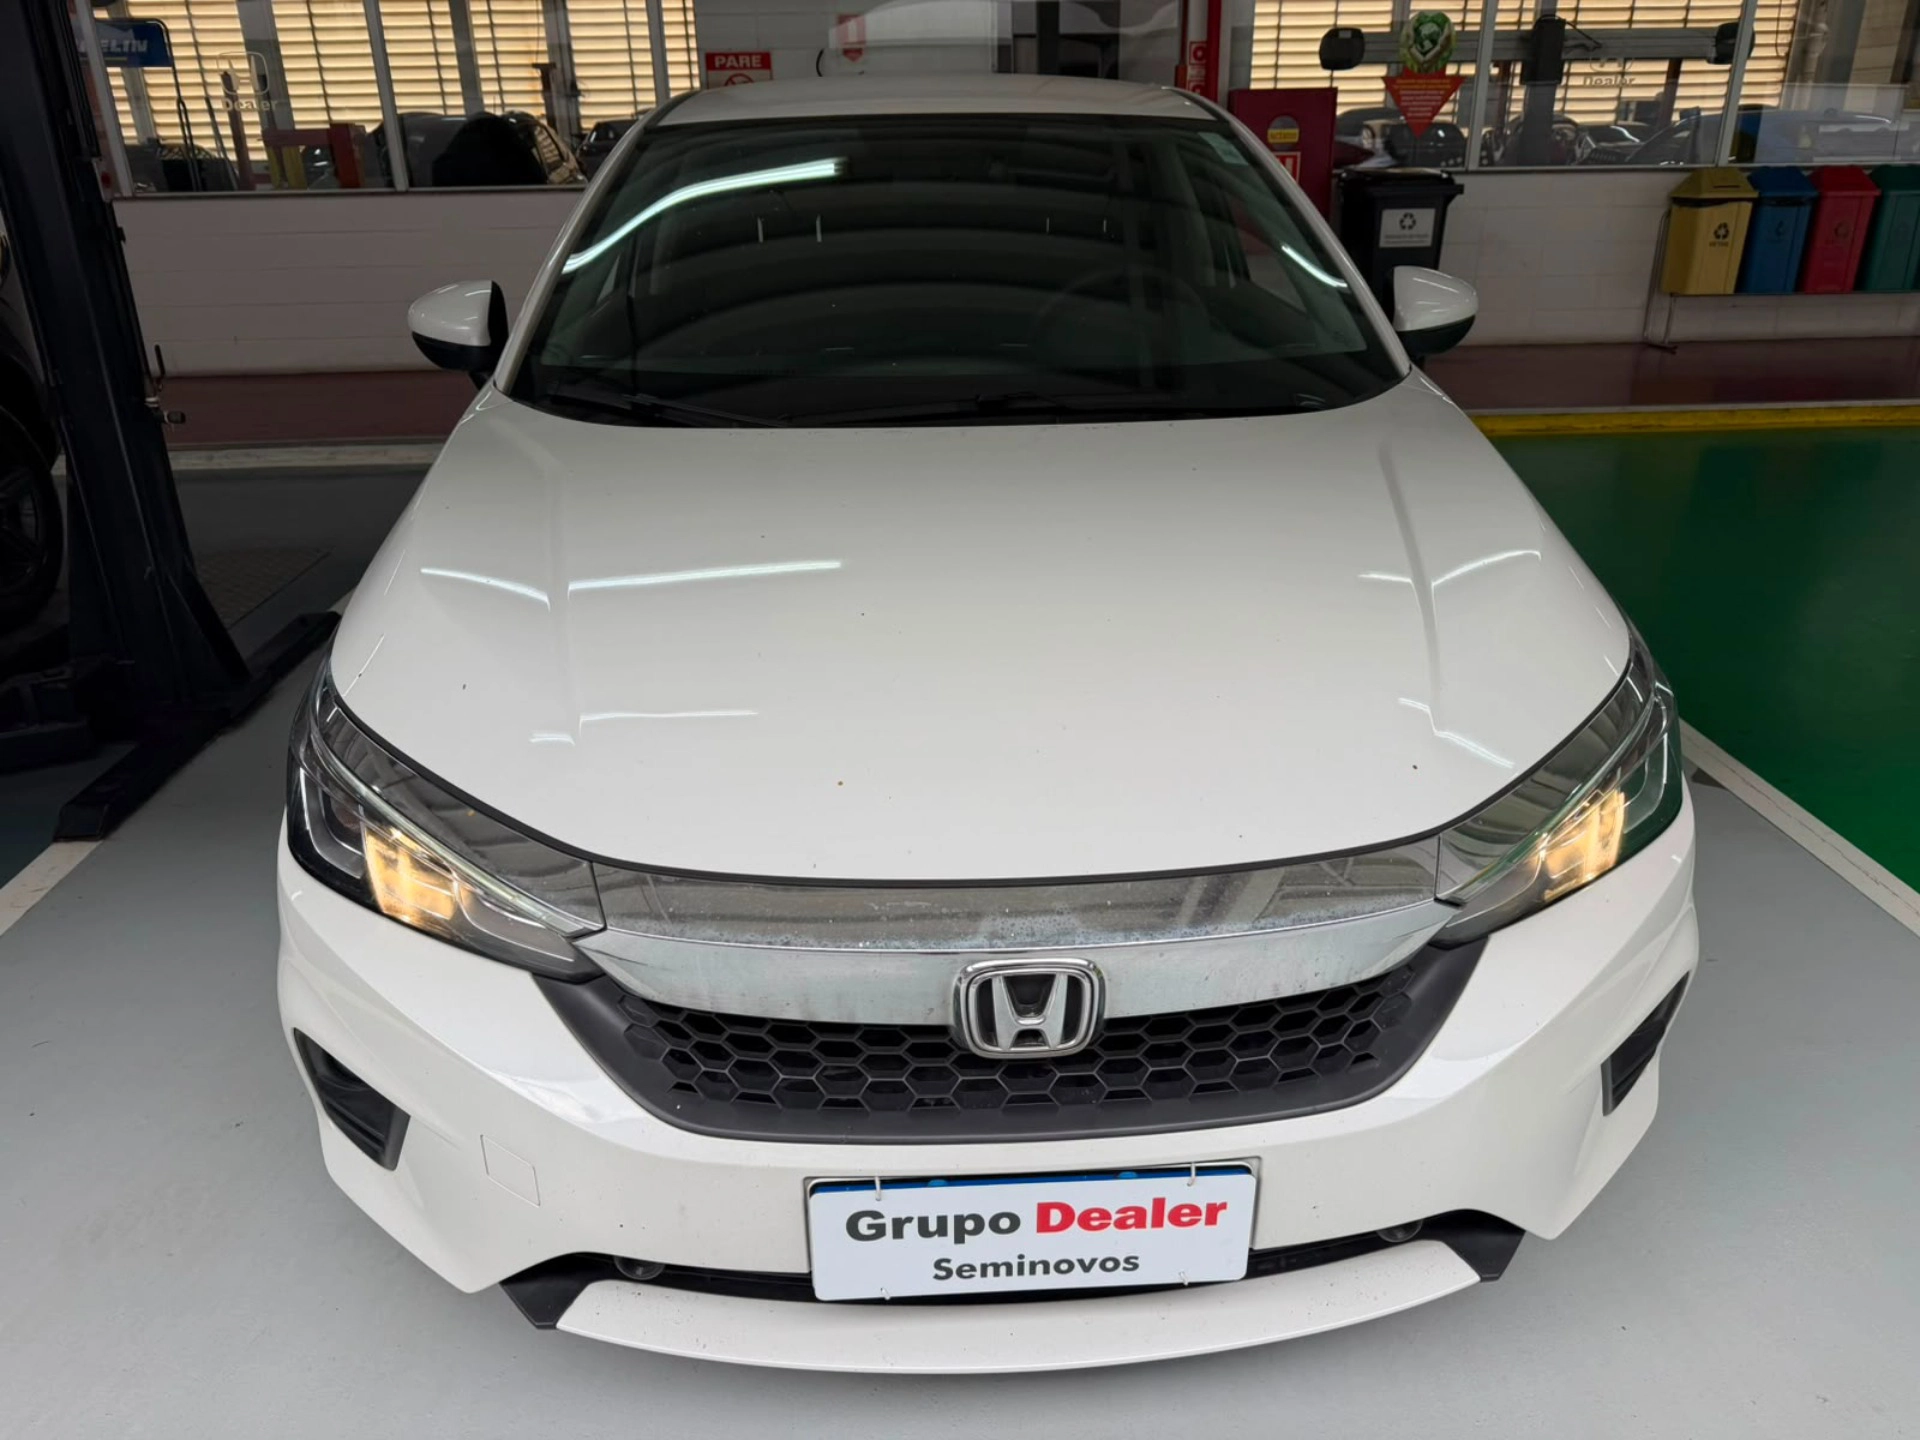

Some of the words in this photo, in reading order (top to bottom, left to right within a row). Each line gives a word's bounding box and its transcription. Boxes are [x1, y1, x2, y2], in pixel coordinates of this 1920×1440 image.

[713, 54, 763, 69] PARE
[1583, 74, 1636, 87] Dealer
[221, 97, 278, 112] Dealer
[845, 1209, 1021, 1245] Grupo
[1036, 1197, 1228, 1234] Dealer
[932, 1253, 1140, 1282] Seminovos
